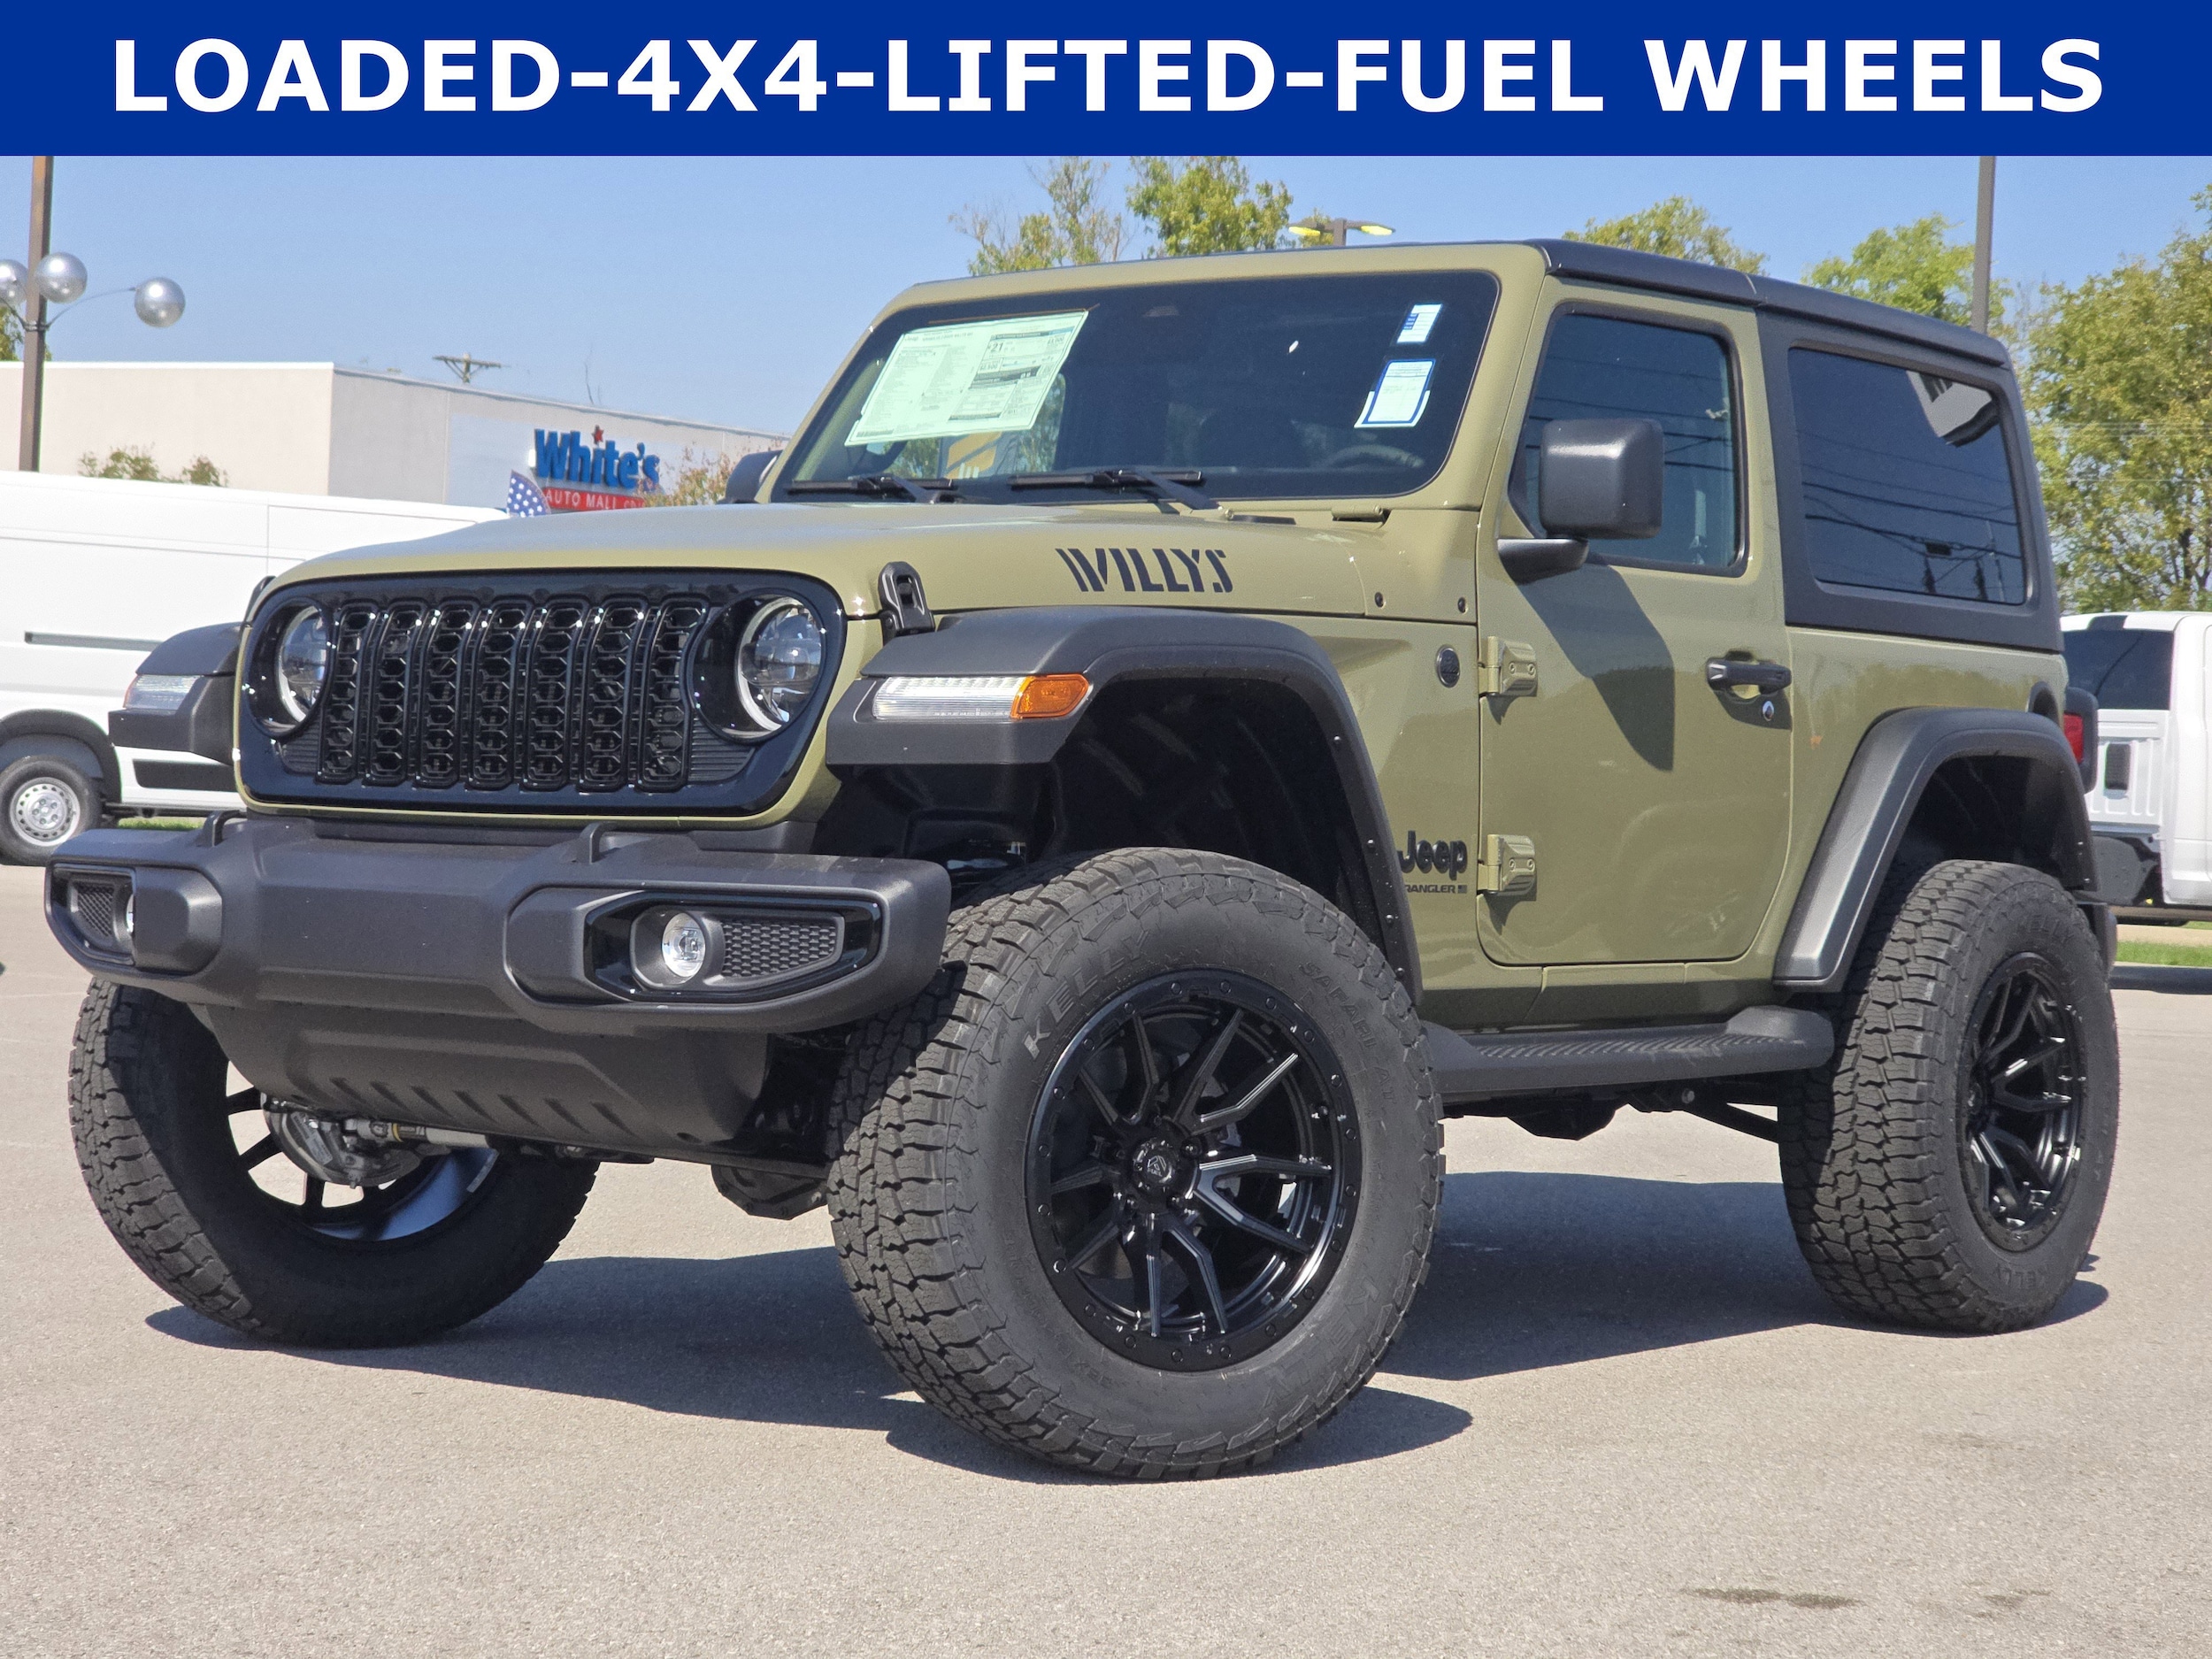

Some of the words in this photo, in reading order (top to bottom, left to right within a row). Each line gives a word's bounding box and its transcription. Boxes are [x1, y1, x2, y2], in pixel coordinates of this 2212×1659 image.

[534, 427, 660, 490] White's
[545, 491, 580, 507] AUTO
[586, 493, 617, 510] MALL
[1054, 547, 1234, 594] WILLYS
[1396, 830, 1468, 881] Jeep
[1404, 884, 1456, 894] RANGLER
[1021, 930, 1149, 1061] KELLY
[1297, 961, 1377, 1050] SAFARI
